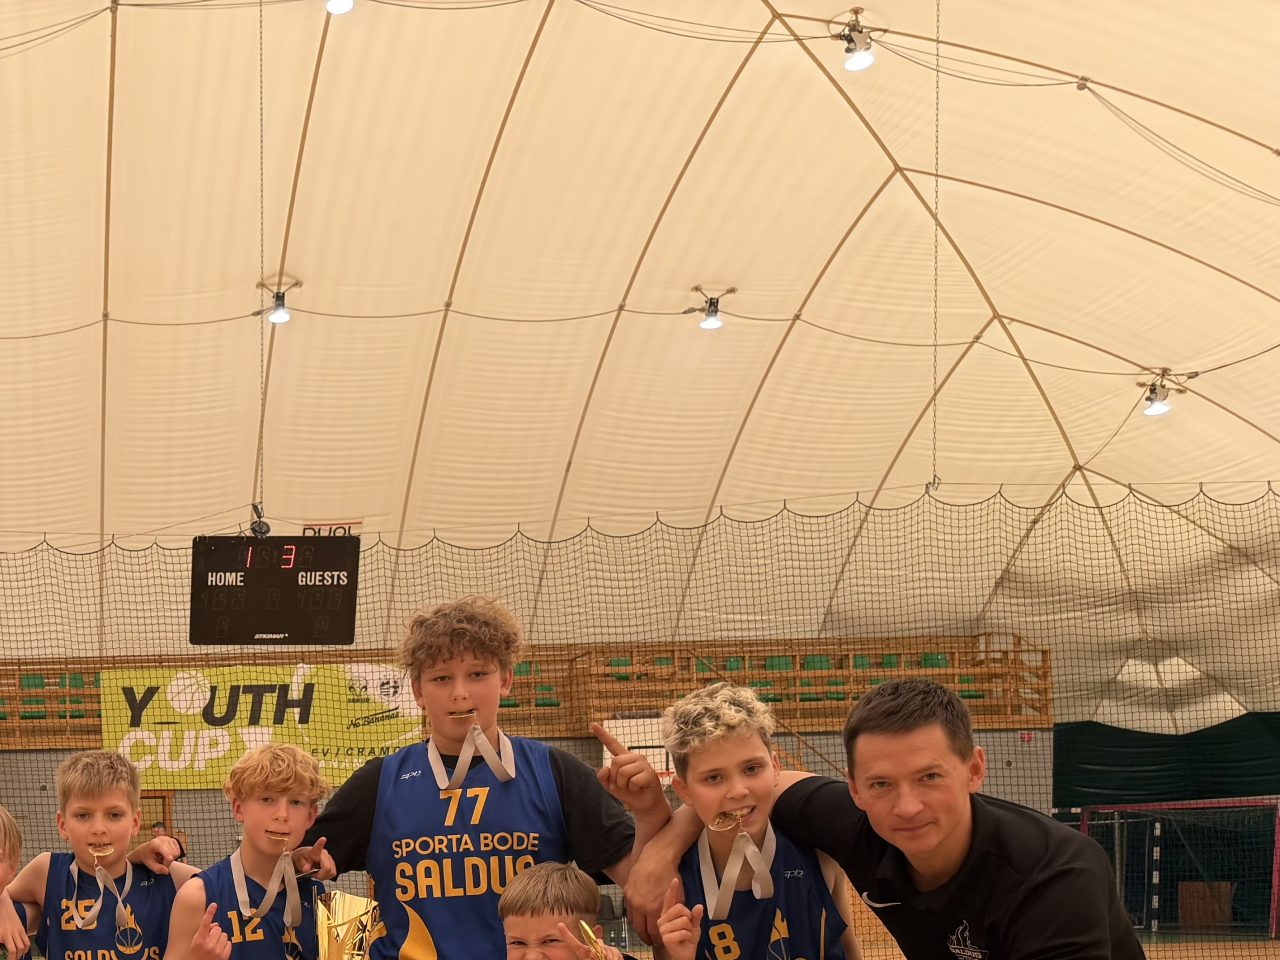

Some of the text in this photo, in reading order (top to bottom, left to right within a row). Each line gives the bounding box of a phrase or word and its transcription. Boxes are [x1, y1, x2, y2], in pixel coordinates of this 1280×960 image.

[280, 545, 296, 568] 3
[207, 571, 348, 586] HOME GUESTS
[120, 727, 231, 771] CUP
[439, 787, 490, 827] 77
[391, 832, 540, 860] SPORTA BODE
[227, 907, 265, 944] 12
